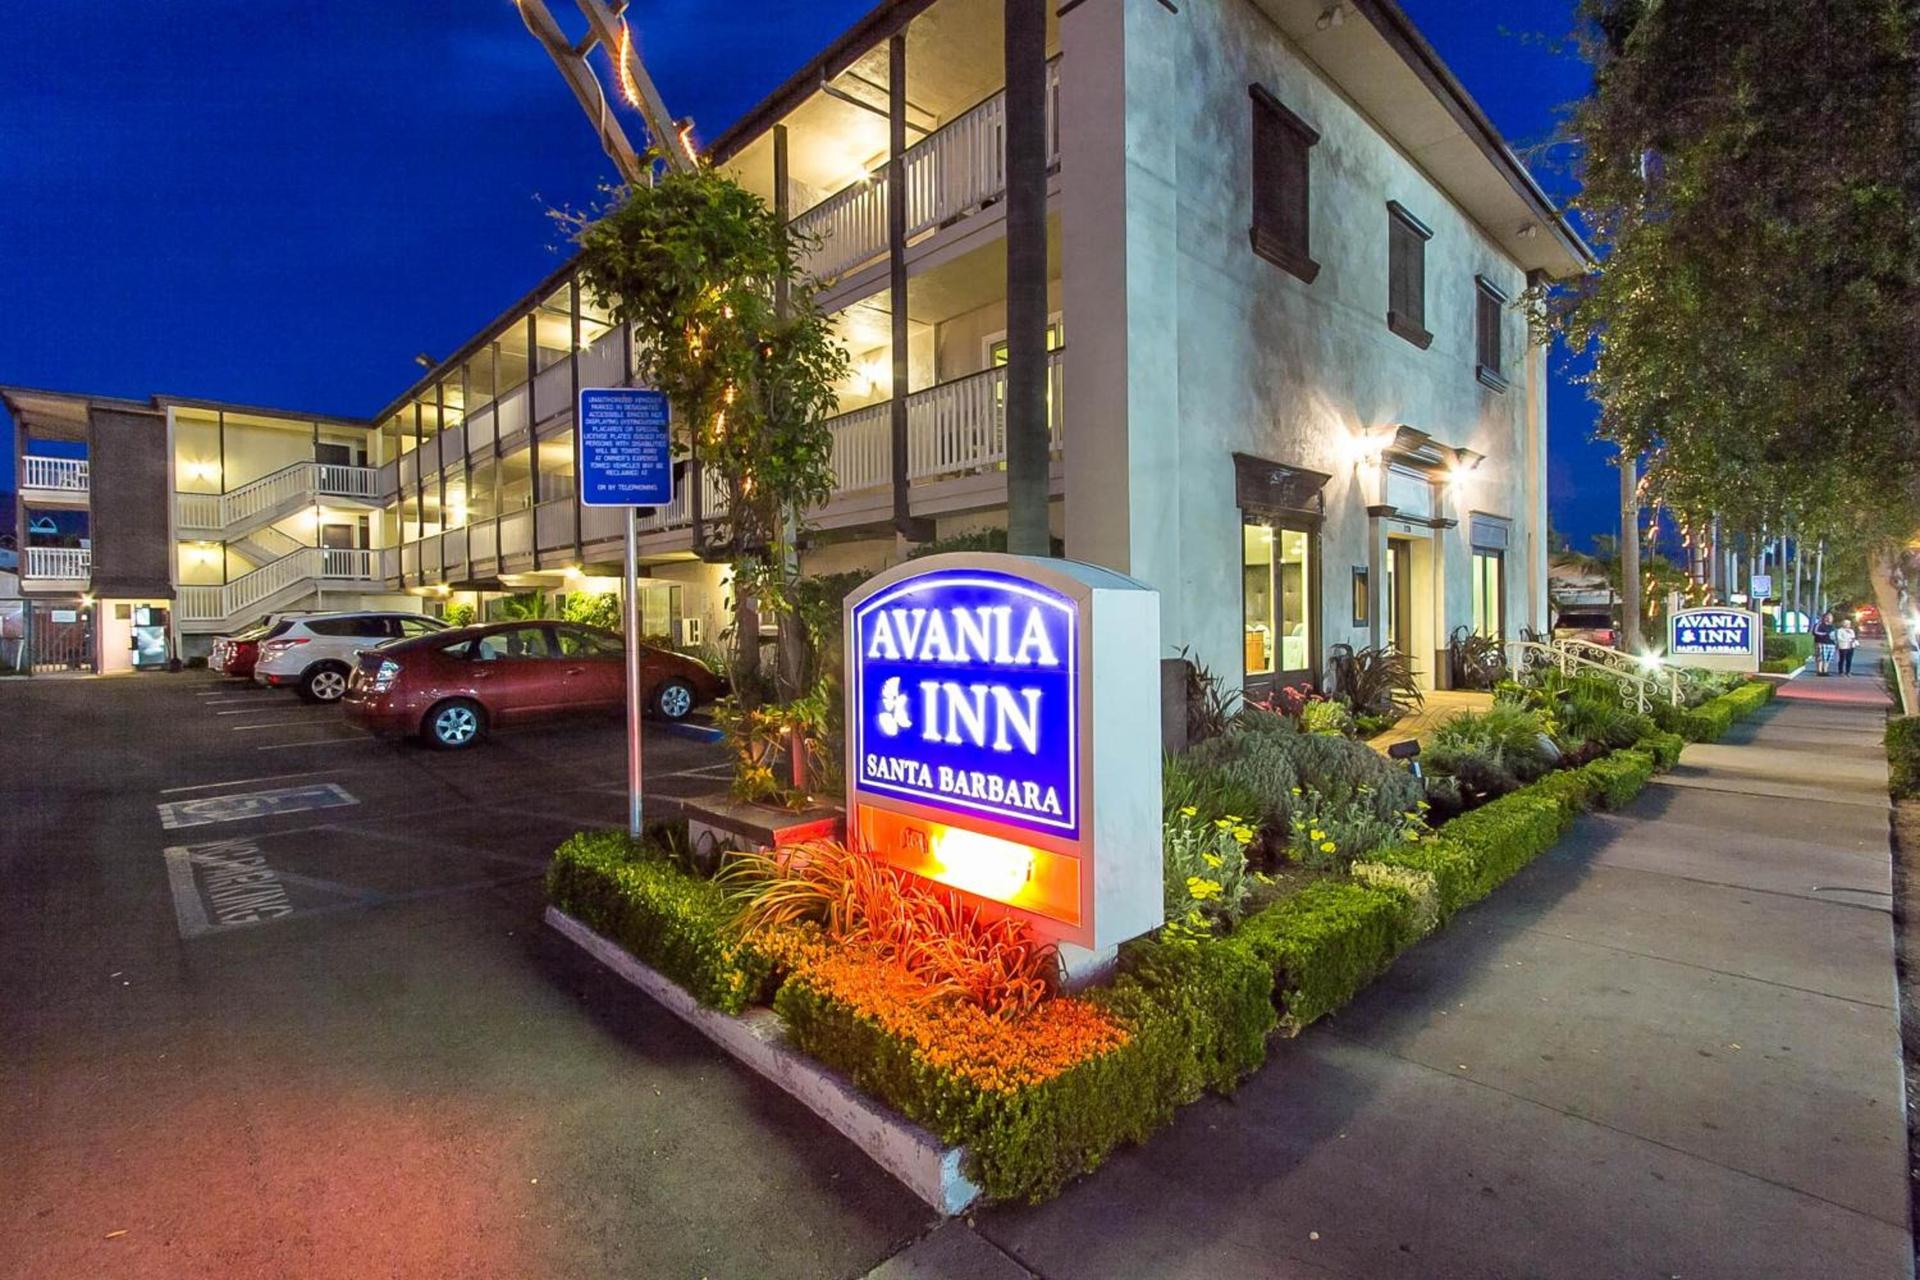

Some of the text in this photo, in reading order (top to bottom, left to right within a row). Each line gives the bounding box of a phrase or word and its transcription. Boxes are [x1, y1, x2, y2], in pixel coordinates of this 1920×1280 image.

[867, 606, 1059, 665] AVANIA
[1678, 615, 1747, 628] AVANIA
[1699, 630, 1742, 643] INN
[918, 679, 1042, 755] INN
[867, 753, 1062, 815] SANTA BARBARA
